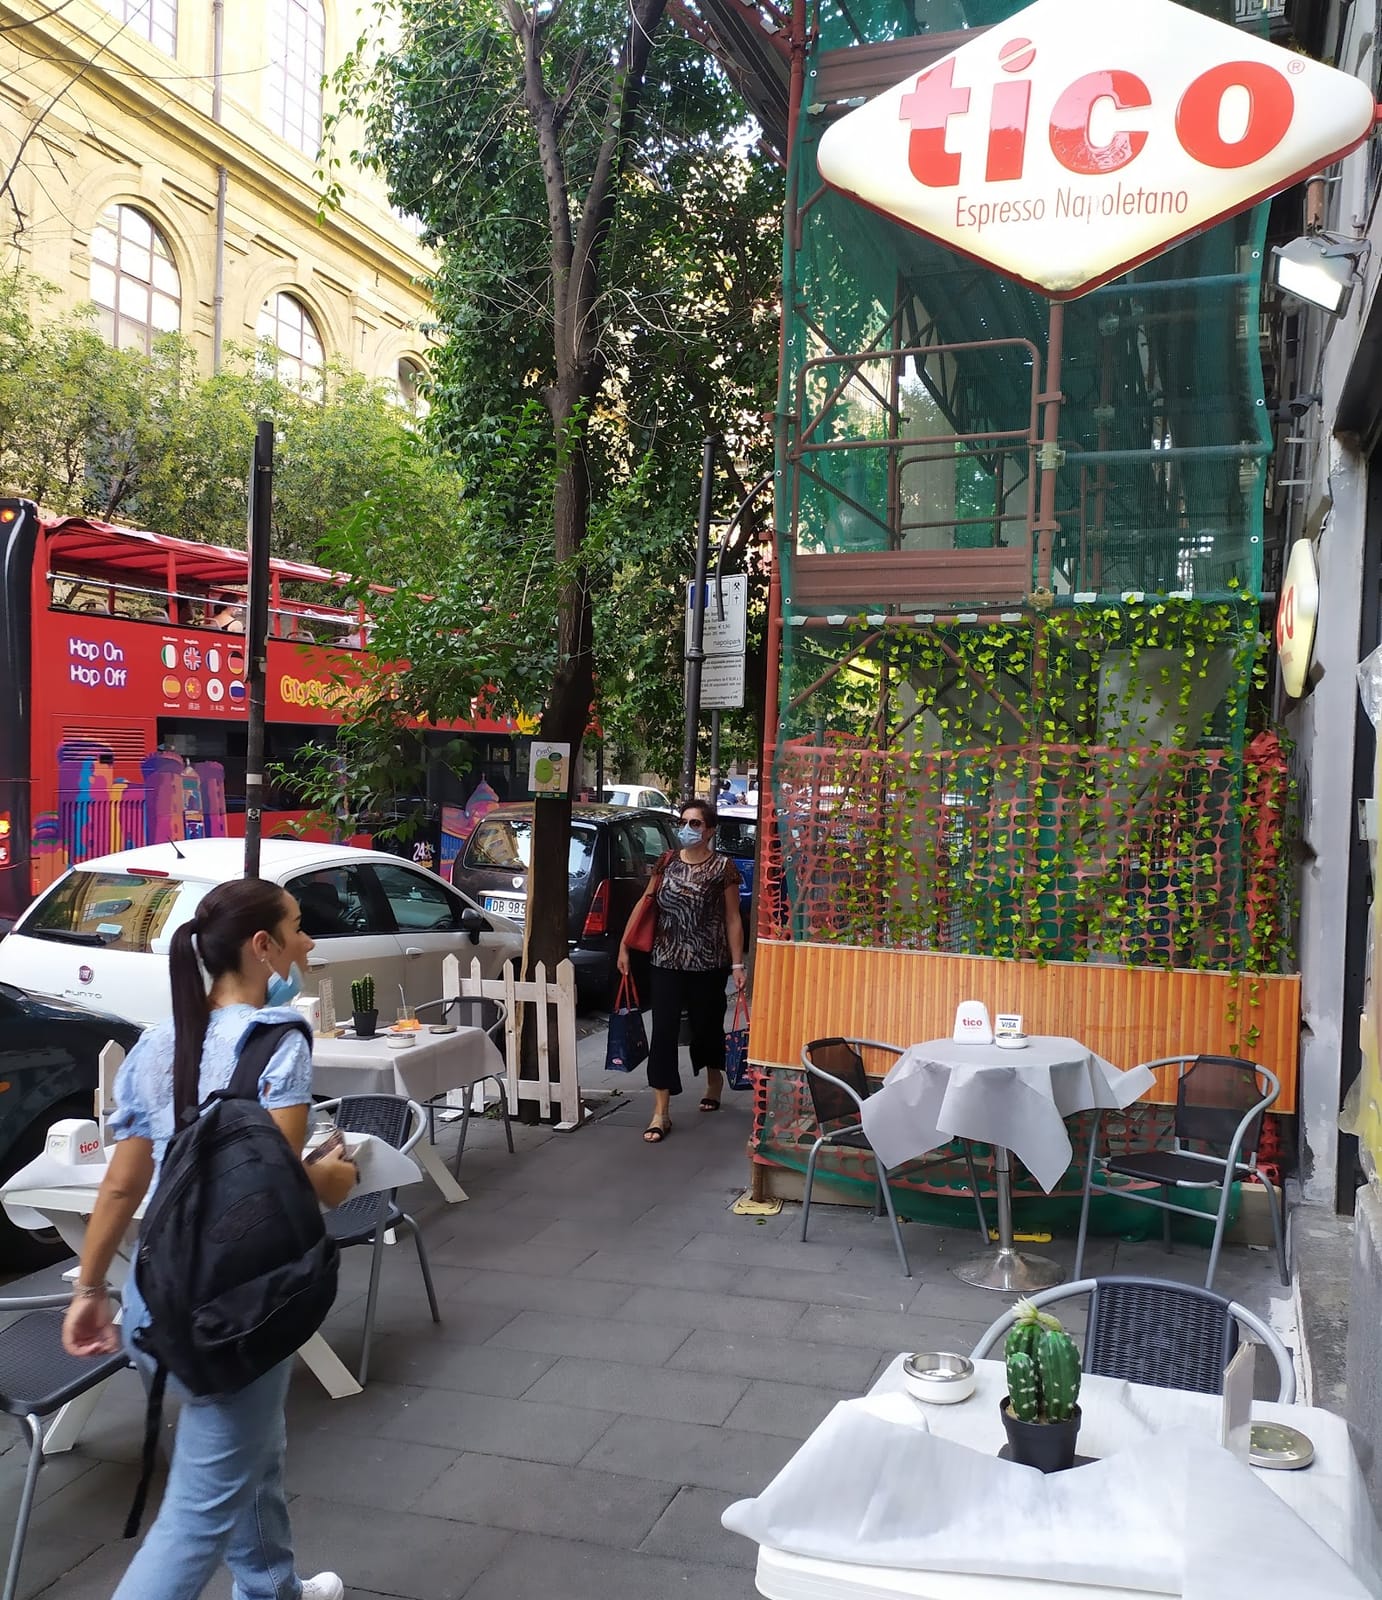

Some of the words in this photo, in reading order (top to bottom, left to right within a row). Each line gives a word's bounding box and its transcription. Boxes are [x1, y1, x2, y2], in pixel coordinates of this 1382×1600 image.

[899, 37, 1294, 188] tico
[955, 195, 1045, 233] Espresso
[69, 637, 100, 662] Hop
[103, 641, 124, 662] On
[70, 664, 101, 688] Hop
[104, 667, 127, 688] Off
[492, 900, 505, 912] DB
[65, 989, 103, 999] PUNTO
[962, 1018, 983, 1026] tico
[1001, 1021, 1017, 1029] VISA
[79, 1140, 99, 1154] tico
